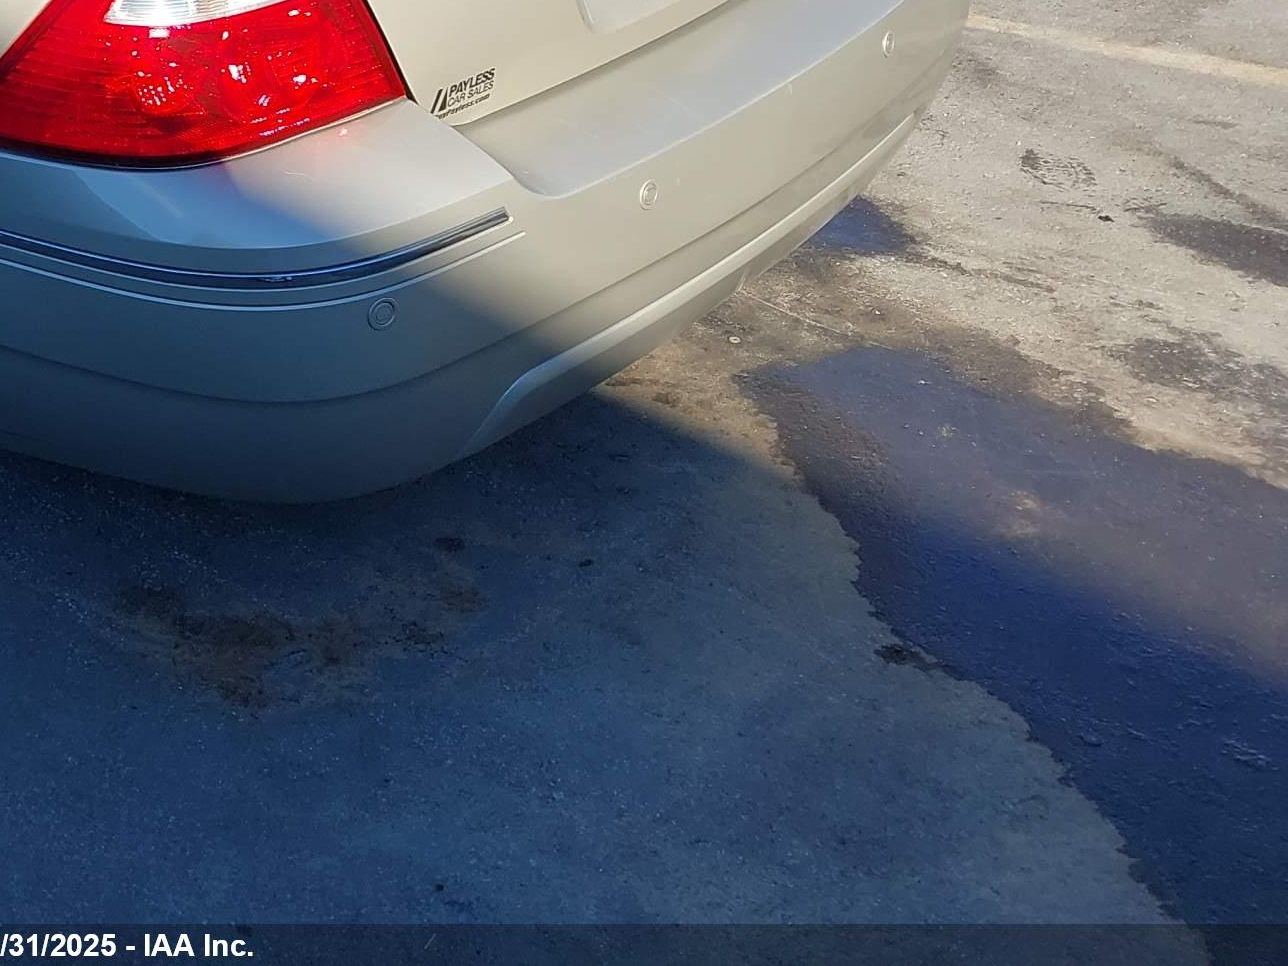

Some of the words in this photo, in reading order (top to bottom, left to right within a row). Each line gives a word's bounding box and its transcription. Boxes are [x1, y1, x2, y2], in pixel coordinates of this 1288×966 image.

[447, 92, 466, 107] CAR
[467, 80, 494, 99] SALES
[448, 67, 496, 98] PAYLESS
